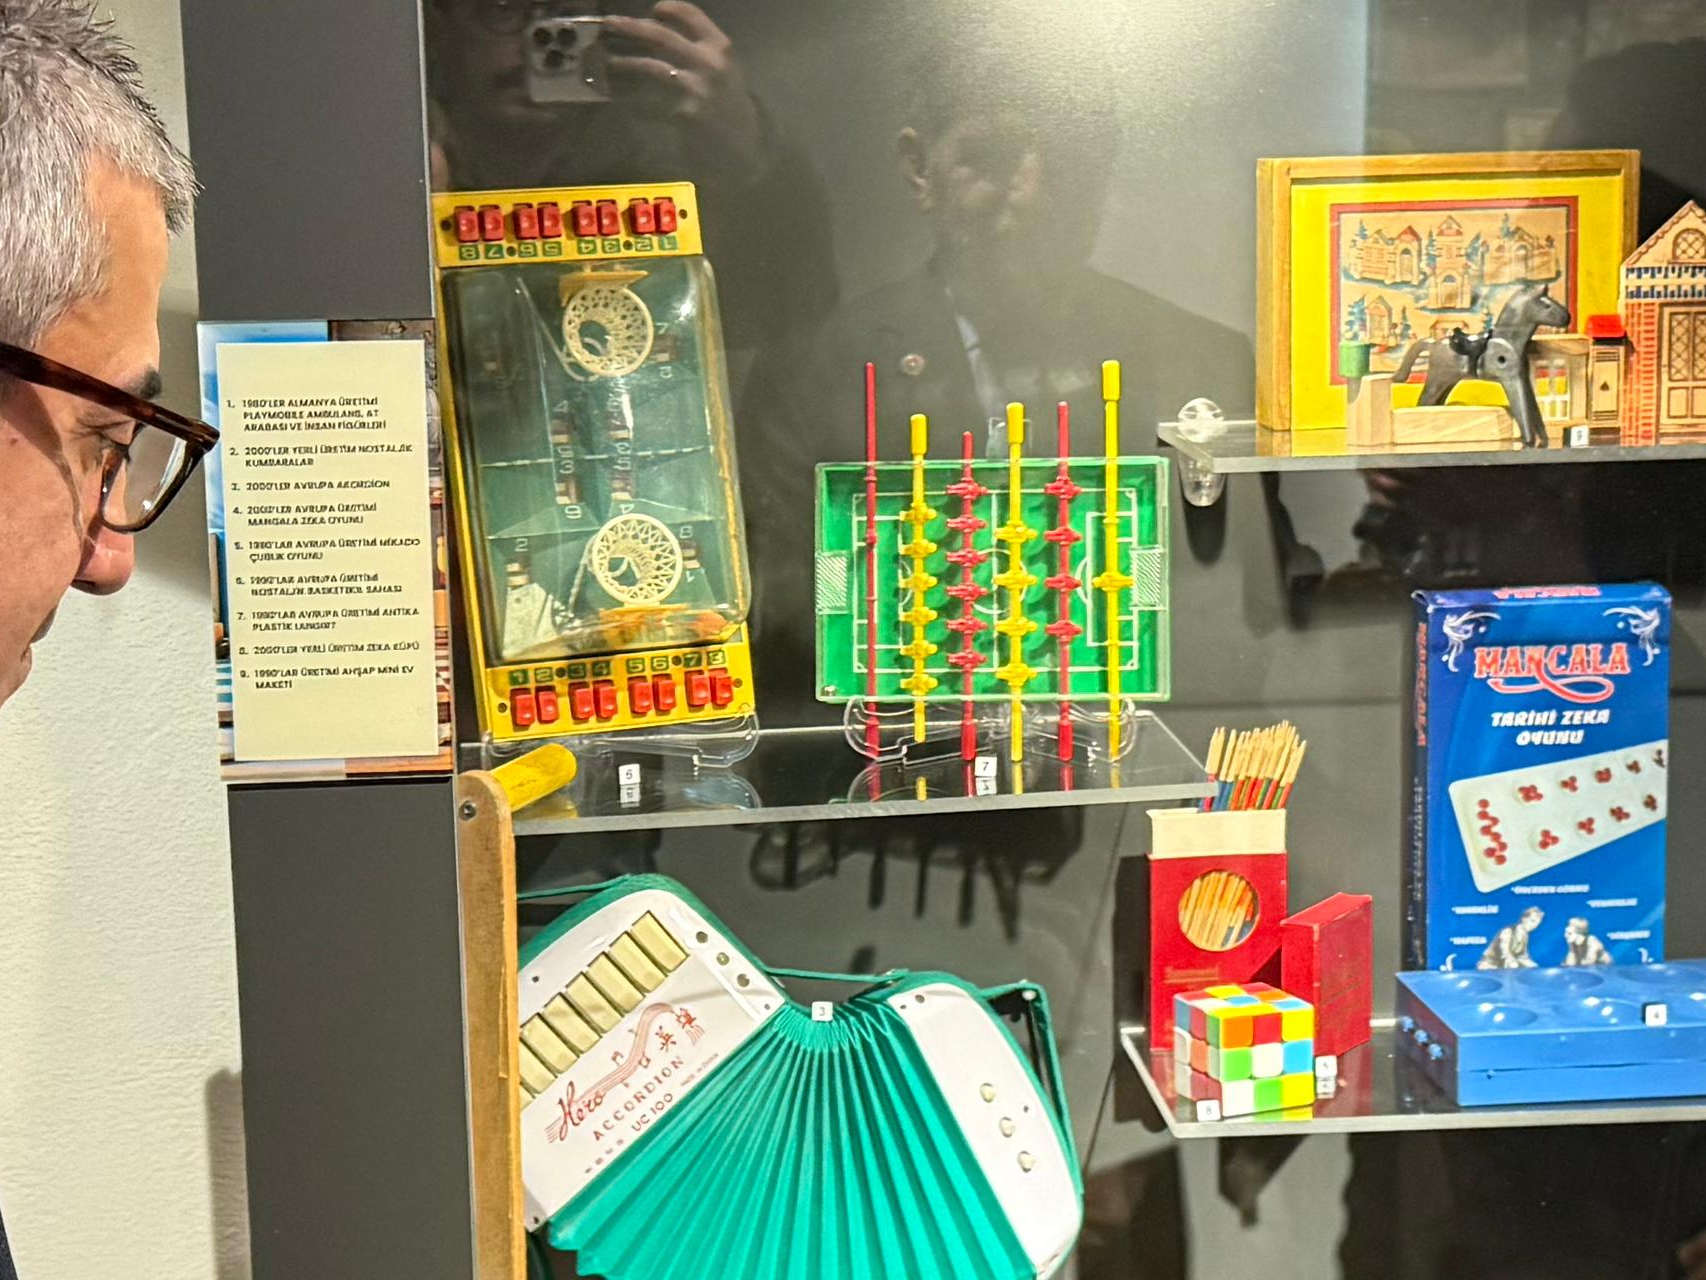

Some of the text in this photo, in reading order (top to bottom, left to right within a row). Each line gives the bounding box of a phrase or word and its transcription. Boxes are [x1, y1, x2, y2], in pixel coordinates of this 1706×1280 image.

[288, 399, 336, 407] ALMANYA
[230, 448, 238, 456] 2.
[1474, 643, 1631, 704] MANCALA
[1560, 709, 1610, 726] ZEKA
[1516, 730, 1584, 746] OYUNU
[557, 1081, 605, 1141] Hero
[593, 1056, 685, 1141] ACCORDION
[631, 1092, 674, 1132] UC 100
